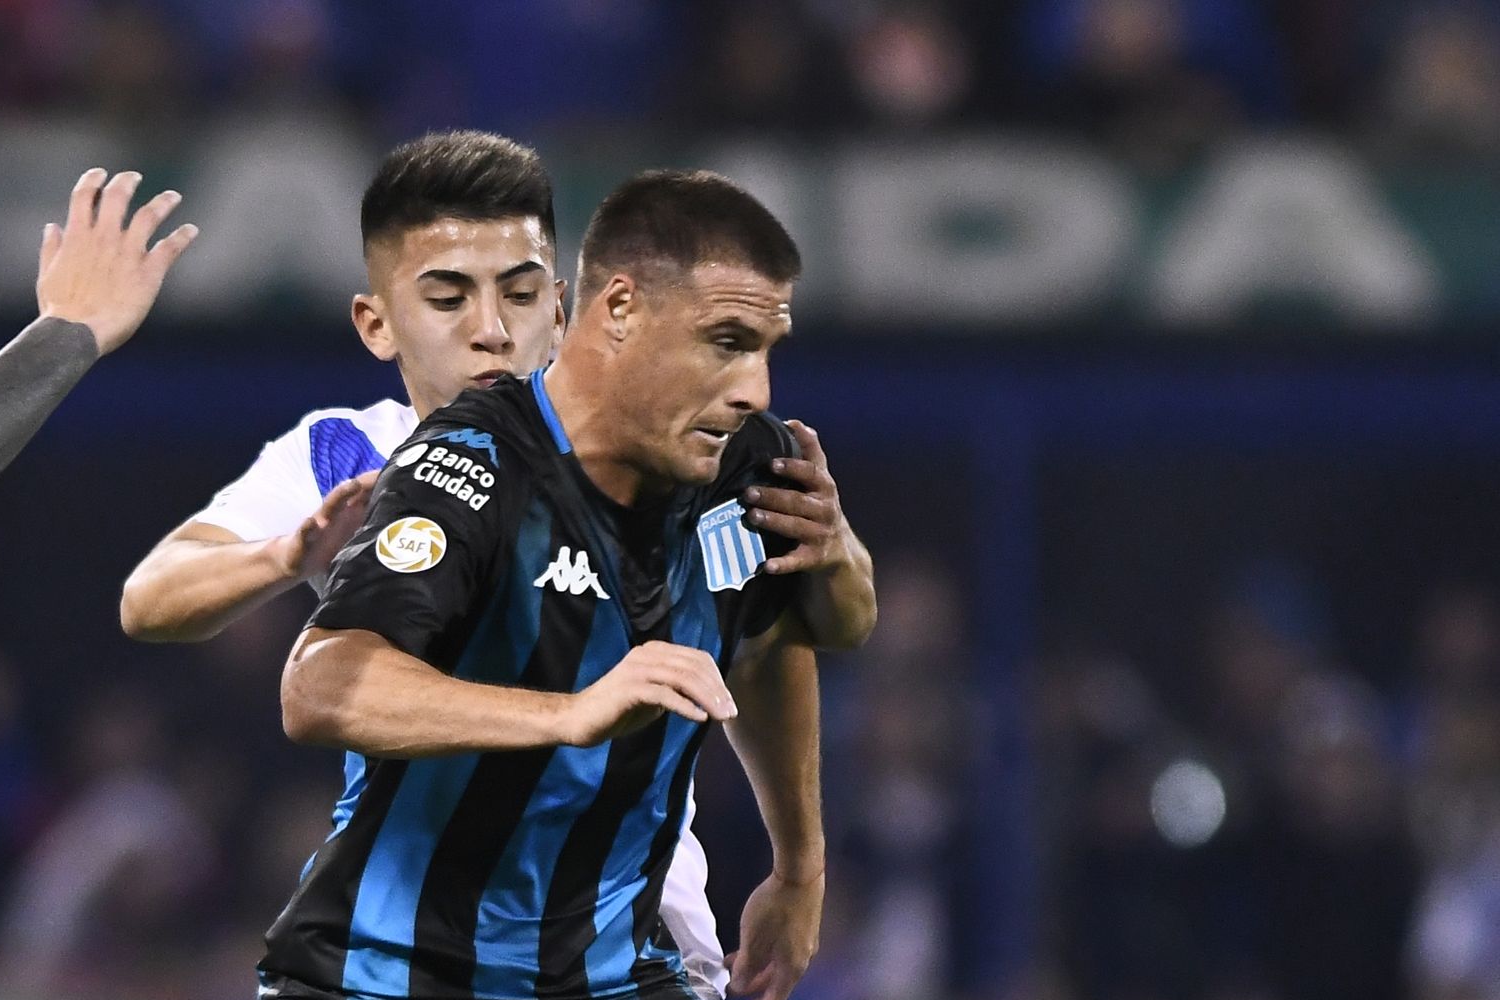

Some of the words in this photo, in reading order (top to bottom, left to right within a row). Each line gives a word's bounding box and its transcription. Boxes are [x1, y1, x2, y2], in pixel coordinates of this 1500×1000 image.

[413, 462, 490, 511] Ciudad
[426, 446, 495, 488] Banco
[397, 538, 426, 553] SAF
